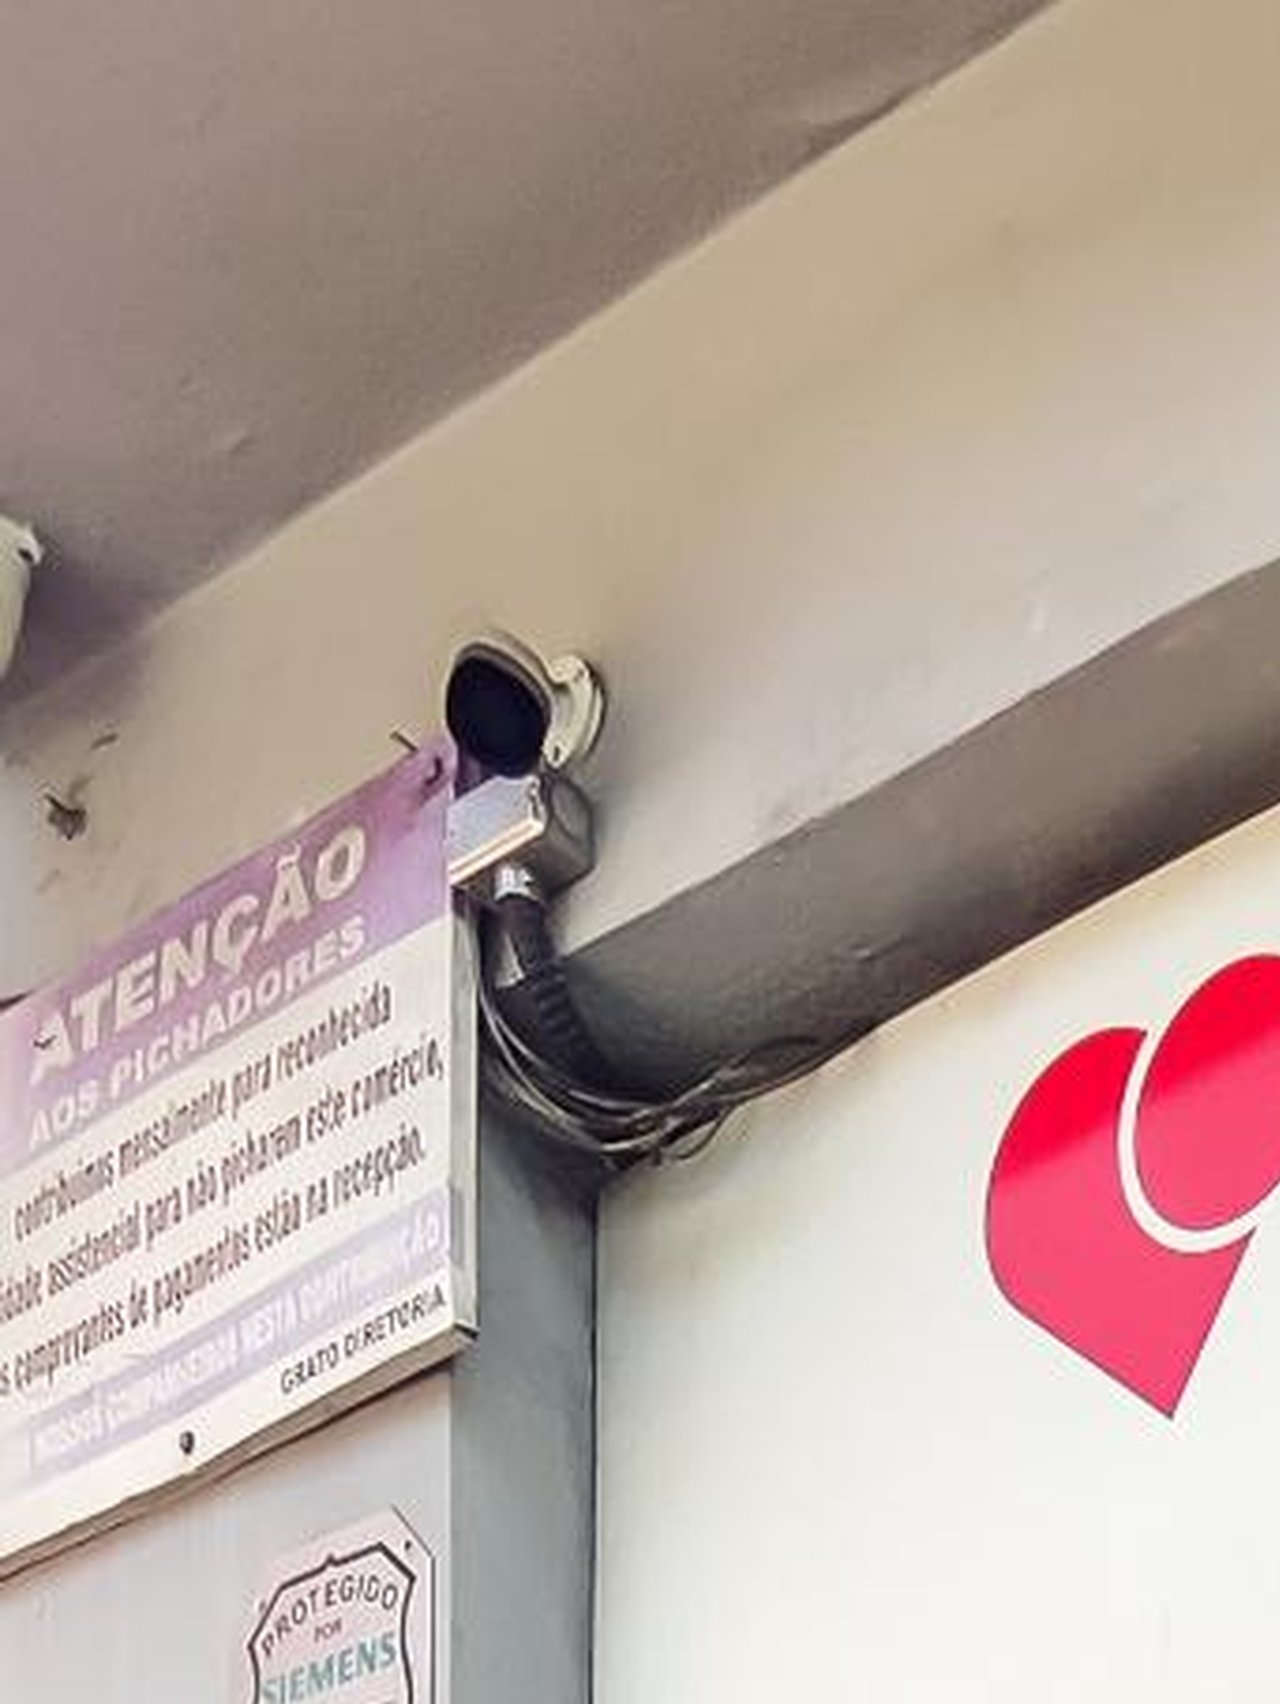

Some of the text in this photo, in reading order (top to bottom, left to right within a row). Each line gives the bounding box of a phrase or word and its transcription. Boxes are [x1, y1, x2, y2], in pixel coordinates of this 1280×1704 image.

[29, 824, 366, 1085] ATENÇÃO
[30, 914, 366, 1150] AOS PICHADORES
[232, 1054, 271, 1121] para
[306, 1084, 346, 1142] este
[130, 1278, 148, 1330] de
[280, 1343, 339, 1394] GRATO
[344, 1284, 446, 1358] DIRETORIA
[261, 1575, 398, 1658] PROTEGIDO
